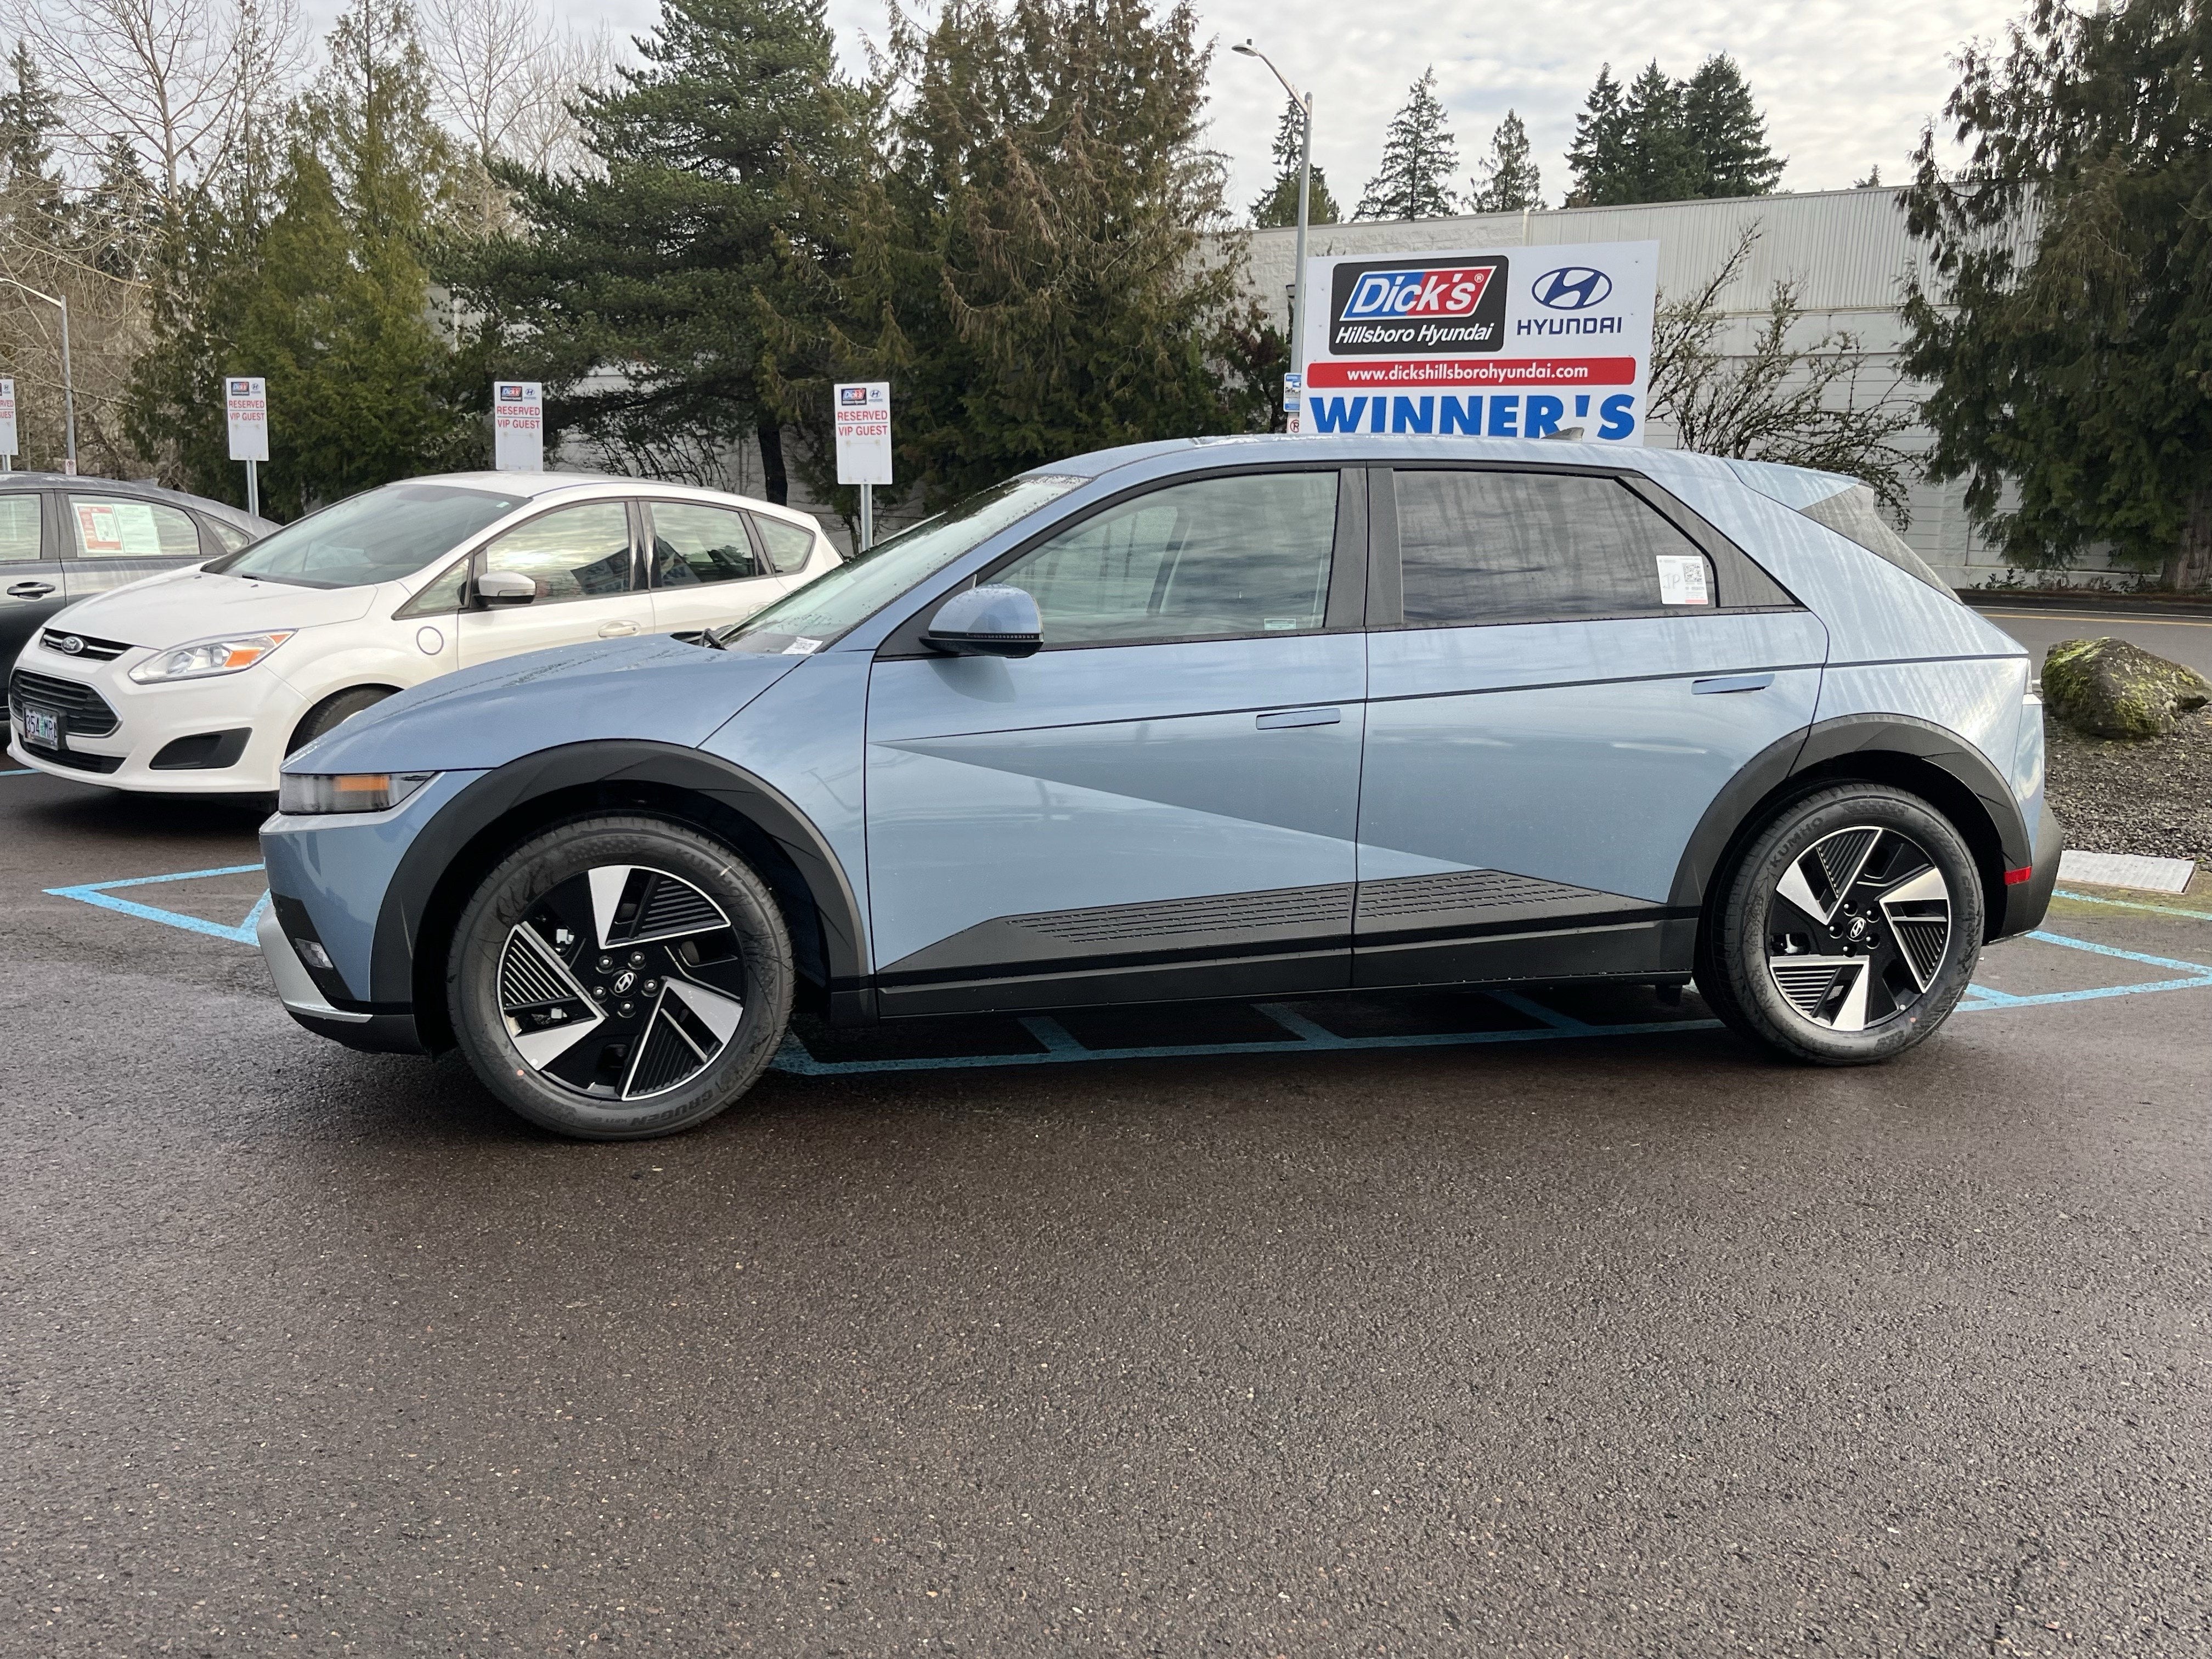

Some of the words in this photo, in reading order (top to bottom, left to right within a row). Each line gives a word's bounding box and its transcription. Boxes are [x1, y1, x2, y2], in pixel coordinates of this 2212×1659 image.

[1516, 317, 1622, 335] HYUNDAI
[1335, 325, 1415, 345] Hillsboro
[1417, 323, 1495, 346] Hyundai
[1347, 362, 1588, 383] www.dickshillsborohyundai.com
[229, 400, 264, 408] RESERVED
[496, 406, 540, 415] RESERVED
[242, 412, 265, 421] GUEST
[838, 410, 888, 421] RESERVED
[1309, 394, 1635, 441] WINNER'S
[497, 419, 510, 428] VIP
[512, 419, 540, 428] GUEST
[838, 426, 853, 436] VIP
[856, 426, 888, 436] GUEST
[1769, 817, 1824, 868] KUMHO
[629, 1088, 714, 1126] CRUGEN
